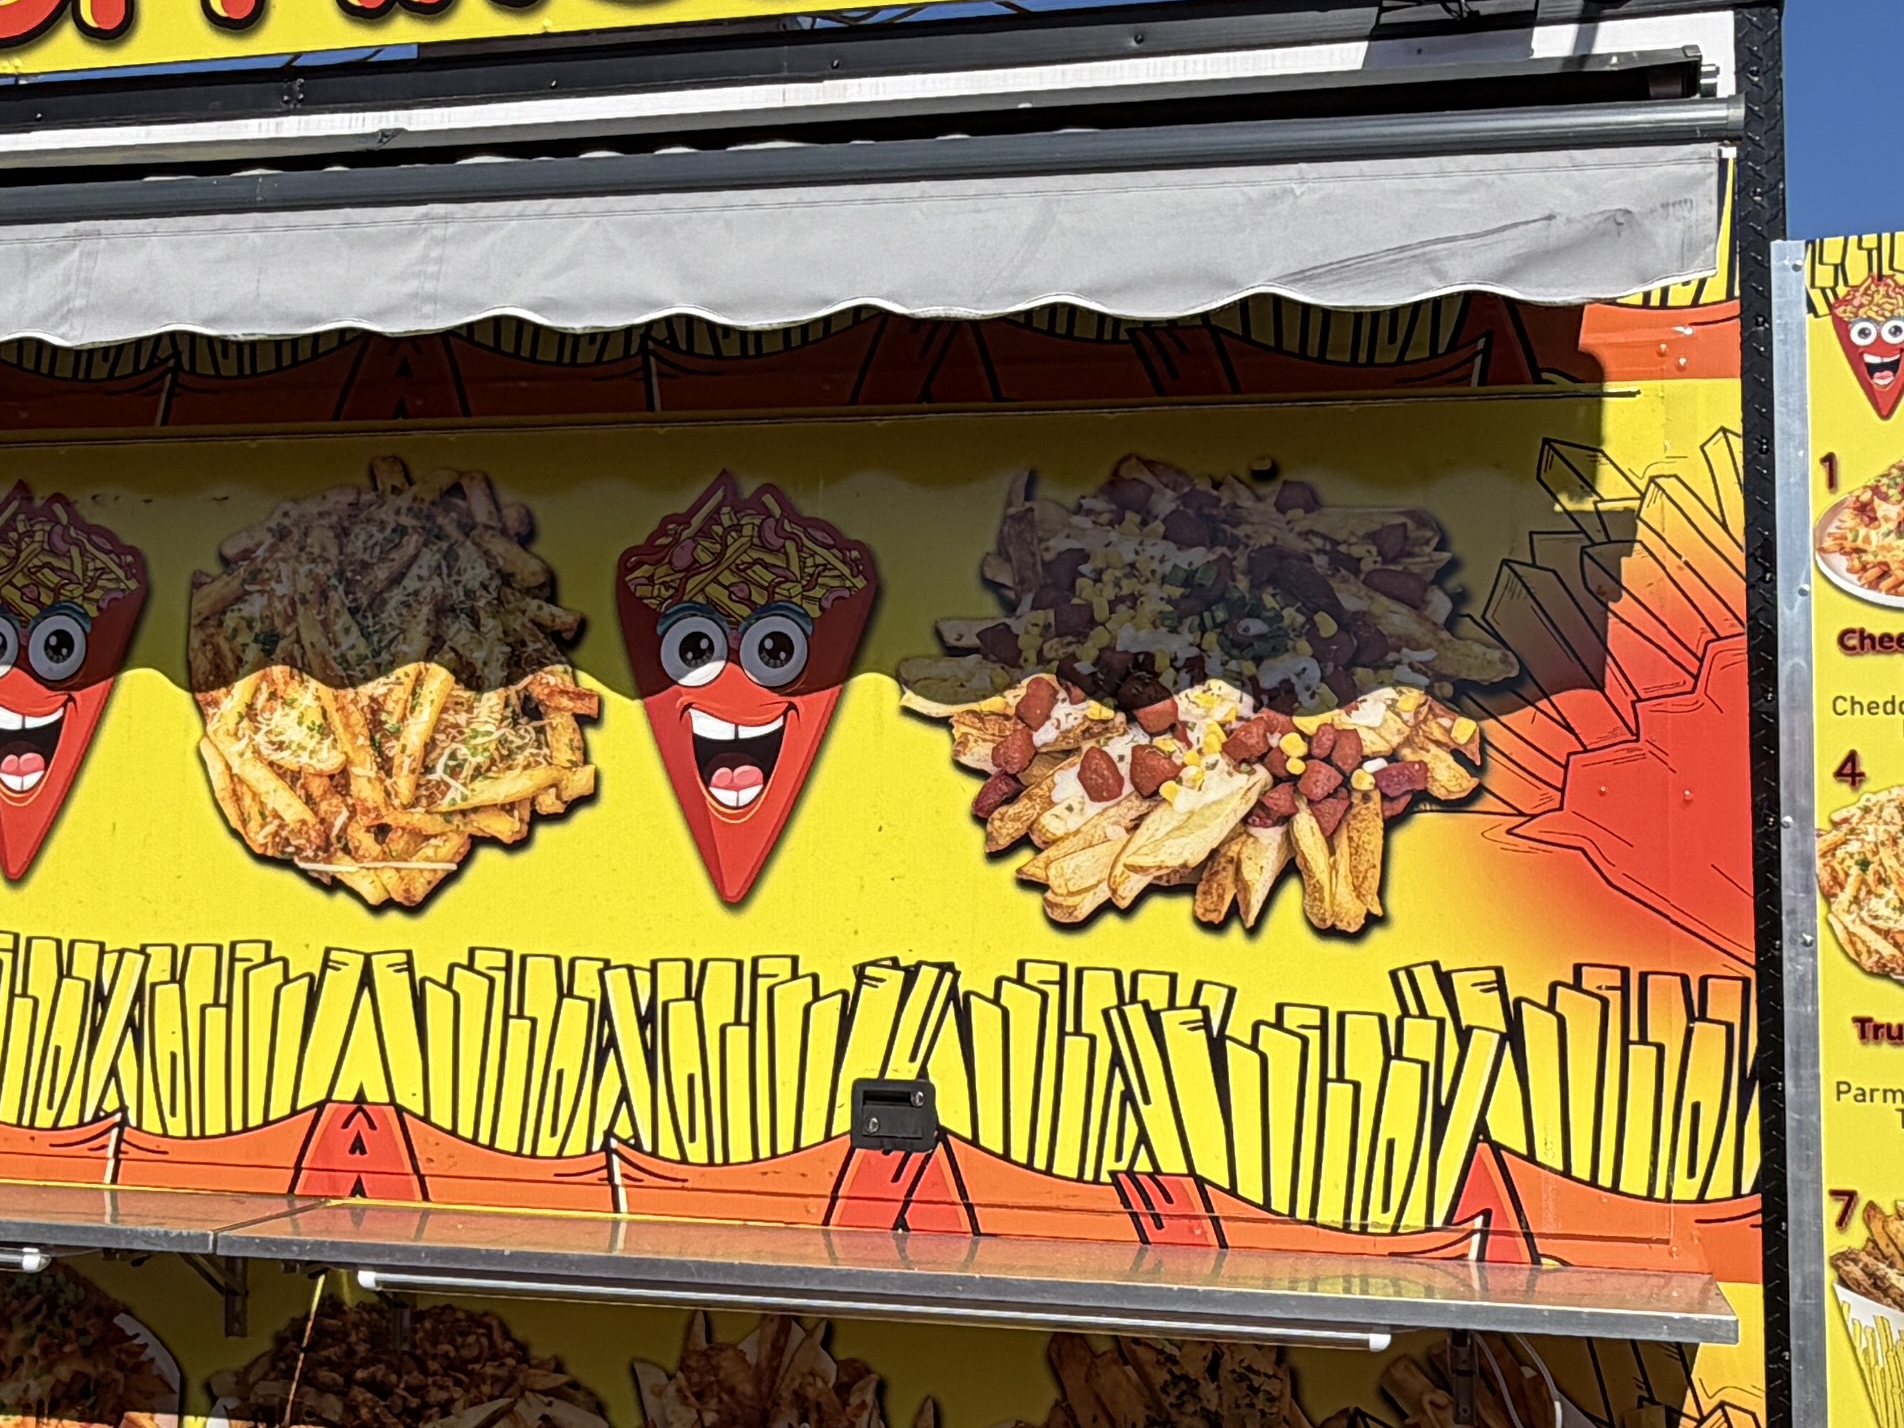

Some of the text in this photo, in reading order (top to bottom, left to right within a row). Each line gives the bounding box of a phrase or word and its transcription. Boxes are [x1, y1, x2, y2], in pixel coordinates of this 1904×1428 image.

[1820, 452, 1839, 491] 1
[1833, 749, 1866, 788] 4
[1829, 1188, 1858, 1230] 7
